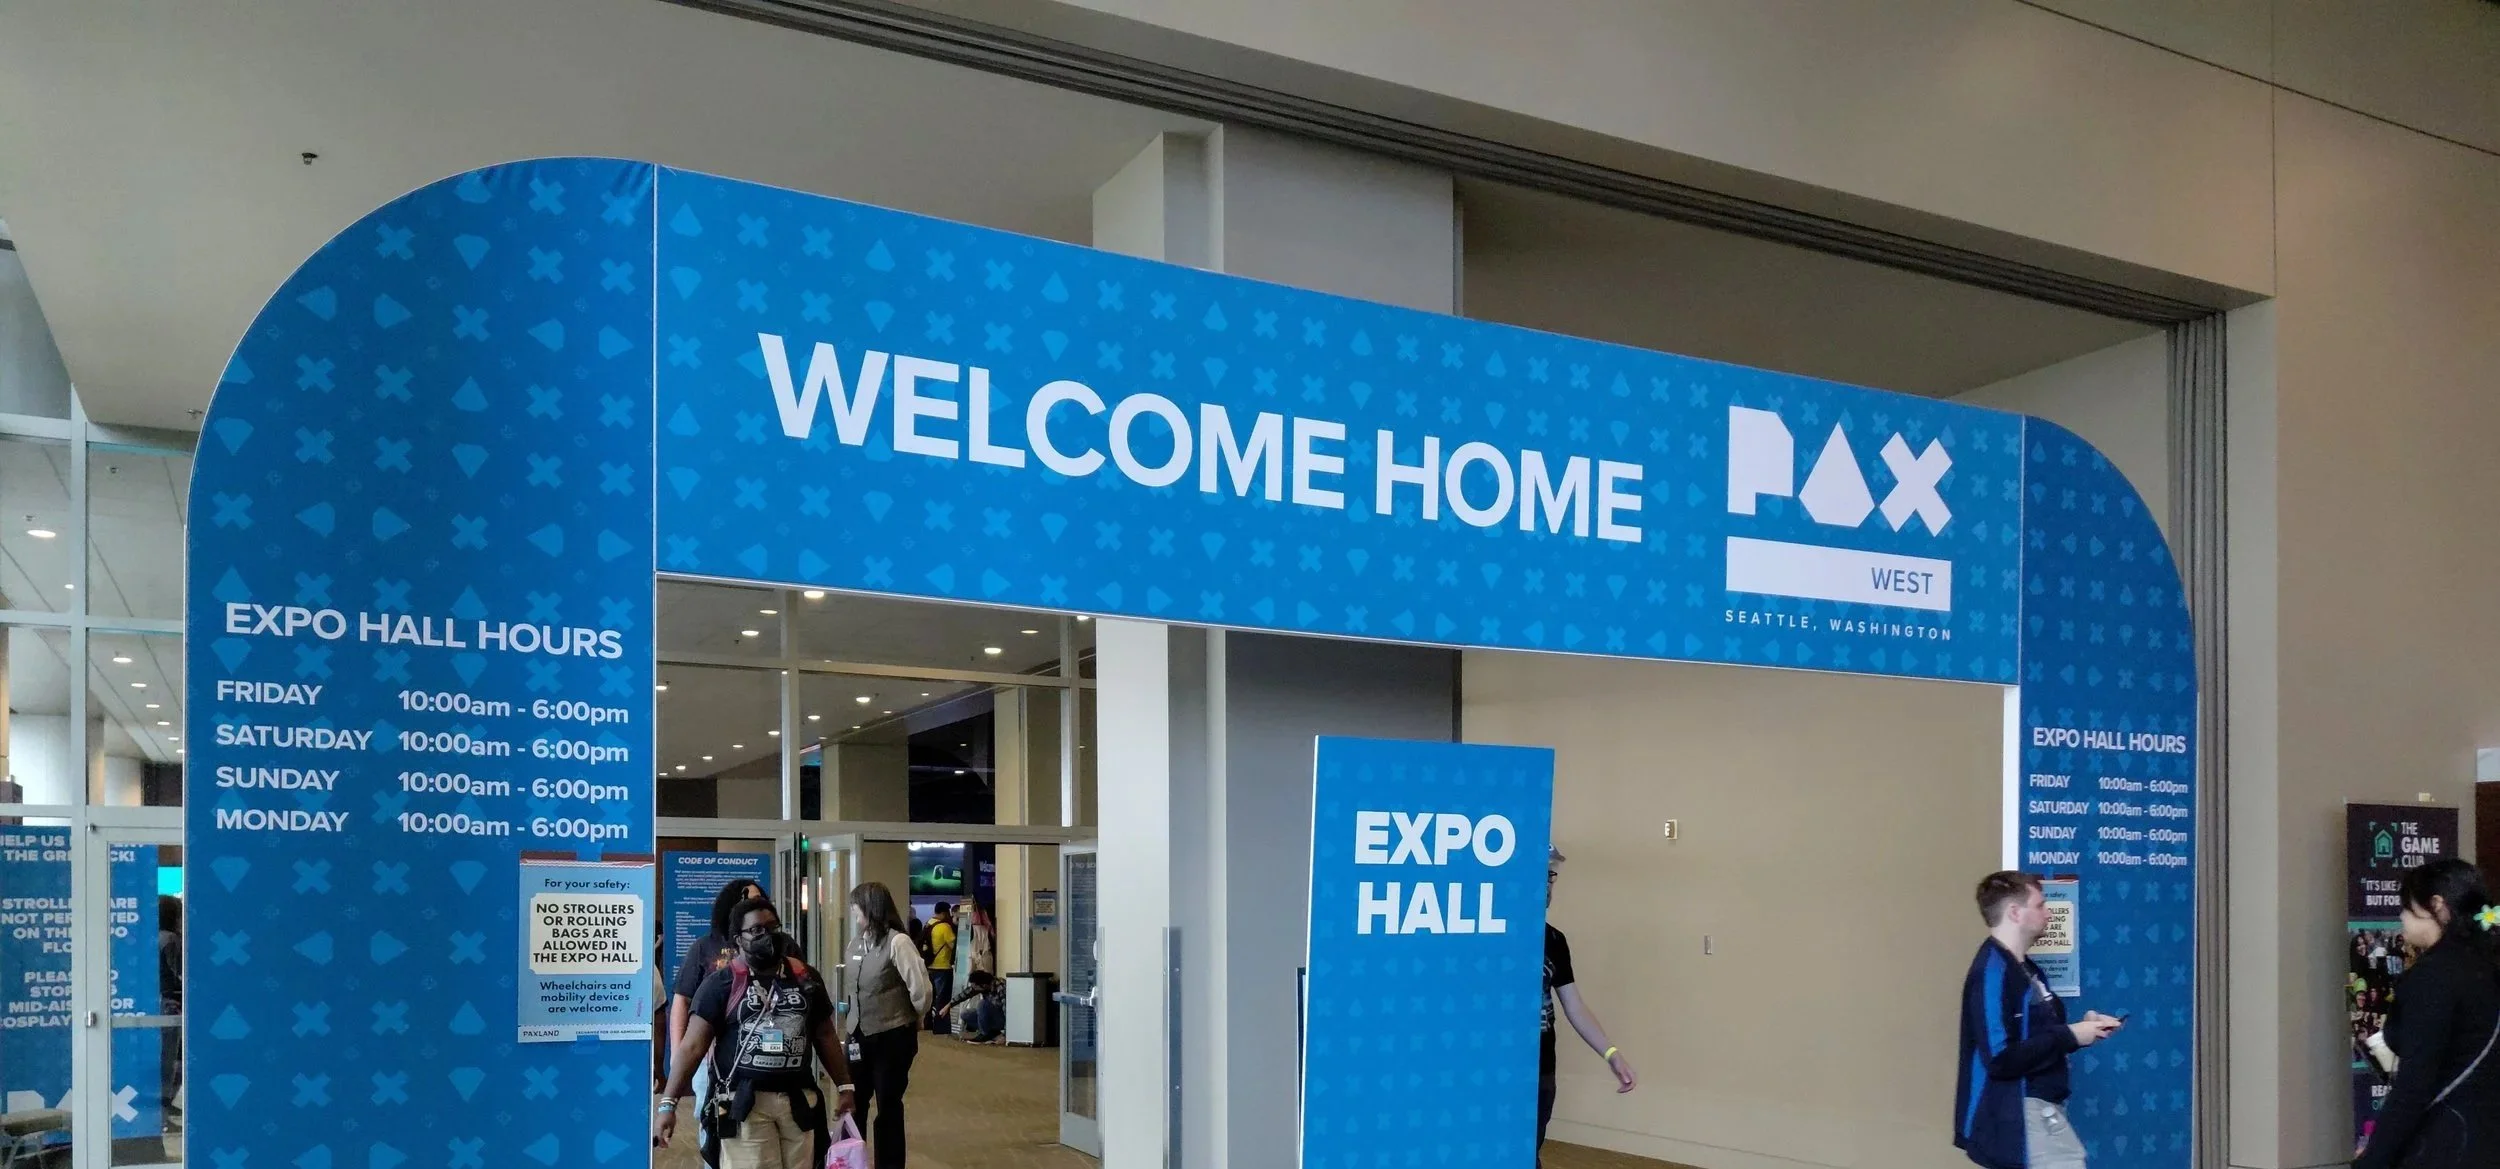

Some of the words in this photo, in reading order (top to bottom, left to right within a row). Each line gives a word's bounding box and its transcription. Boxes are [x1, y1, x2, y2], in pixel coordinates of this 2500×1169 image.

[757, 332, 1346, 509] WELCOME
[1375, 430, 1643, 543] HOME
[1727, 405, 1953, 537] PAX
[1871, 567, 1933, 594] WEST
[225, 602, 347, 640] EXPO
[359, 611, 466, 649] HALL
[478, 620, 623, 659] HOURS
[1725, 609, 1817, 631] SEATTLE,
[1830, 618, 1951, 641] WASHINGTON
[216, 680, 322, 705] FRIDAY
[398, 690, 510, 717] 10:00am
[532, 698, 629, 727] 6:00pm
[216, 724, 373, 751] SATURDAY
[398, 731, 510, 757] 10:00am
[532, 739, 629, 765] 6:00pm
[2033, 727, 2080, 748] EXPO
[2083, 730, 2125, 750] HALL
[2129, 733, 2187, 754] HOURS
[216, 766, 340, 791] SUNDAY
[398, 771, 510, 797] 10:00am
[532, 778, 629, 804] 6:00pm
[2029, 774, 2070, 788] FRIDAY
[2098, 776, 2142, 792] 10:00am
[2149, 779, 2188, 795] 6:00pm
[2029, 801, 2090, 815] SATURDAY
[2098, 802, 2142, 817] 10:00am
[2149, 804, 2188, 820] 6:00pm
[216, 808, 349, 833] MONDAY
[398, 812, 510, 837] 10:00am
[532, 817, 629, 843] 6:00pm
[2401, 822, 2418, 835] THE
[41, 835, 65, 847] US
[1355, 810, 1516, 867] EXPO
[2029, 826, 2077, 839] SUNDAY
[2098, 826, 2141, 841] 10:00am
[2149, 828, 2187, 844] 6:00pm
[2401, 836, 2440, 854] GAME
[6, 851, 38, 861] THE
[678, 857, 702, 865] CODE
[704, 857, 716, 865] OF
[717, 858, 758, 866] CONDUCT
[2029, 852, 2080, 865] MONDAY
[2097, 851, 2141, 866] 10:00am
[2149, 853, 2187, 868] 6:00pm
[2401, 854, 2425, 868] CLUB
[544, 879, 562, 888] For
[565, 880, 589, 890] your
[593, 879, 630, 891] safety:
[2381, 880, 2396, 891] LIKE
[2, 898, 72, 910] STROLL
[2366, 895, 2382, 906] BUT
[2384, 895, 2400, 906] FOR
[536, 903, 559, 914] NO
[563, 904, 635, 914] STROLLERS
[1357, 881, 1506, 935] HALL
[2, 913, 39, 924] NOT
[543, 915, 563, 926] OR
[567, 916, 627, 927] ROLLING
[13, 927, 40, 939] ON
[552, 928, 589, 939] BAGS
[593, 928, 619, 939] ARE
[543, 940, 608, 951] ALLOWED
[612, 941, 627, 951] IN
[533, 953, 557, 963] THE
[561, 952, 597, 963] EXPO
[601, 952, 639, 963] HALL.
[539, 981, 607, 991] Wheelchairs
[609, 981, 631, 990] and
[111, 998, 134, 1010] OR
[540, 992, 586, 1004] mobility
[589, 992, 630, 1001] devices
[570, 1003, 622, 1013] welcome.
[0, 1015, 71, 1028] OSPLAY
